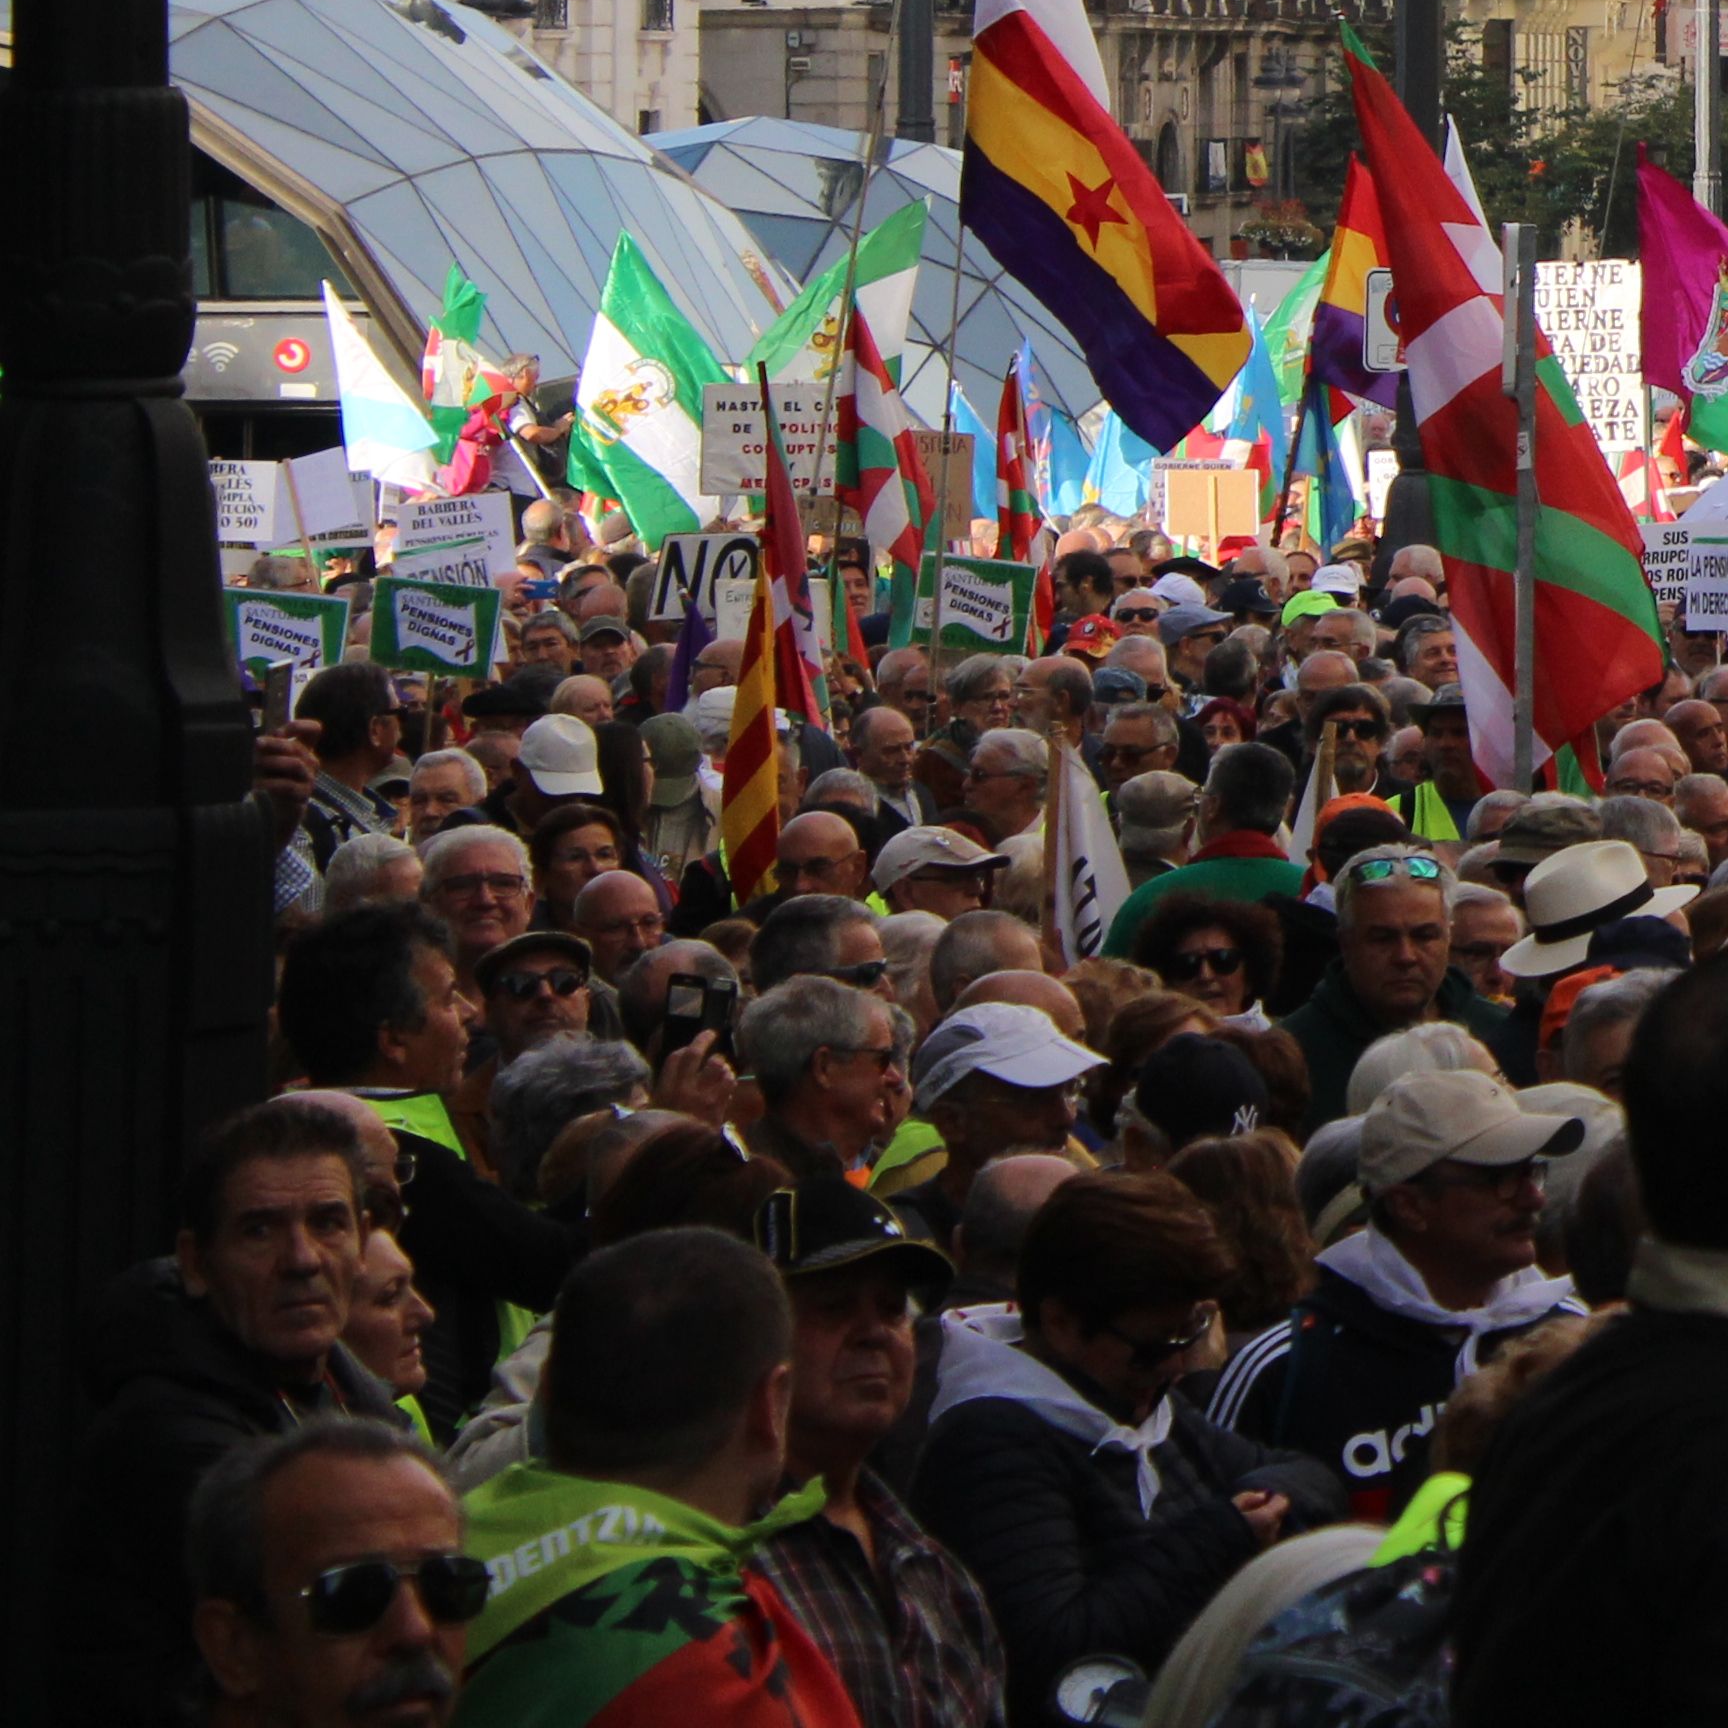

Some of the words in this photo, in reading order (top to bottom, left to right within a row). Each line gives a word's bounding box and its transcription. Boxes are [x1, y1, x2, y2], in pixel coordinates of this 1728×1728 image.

[1590, 332, 1622, 353] DE
[783, 401, 803, 412] EL
[732, 423, 752, 435] DE
[1663, 531, 1689, 545] SUS
[1691, 559, 1702, 578] LA
[943, 581, 1011, 616] PENSIONES
[401, 603, 474, 638] PENSIONES
[948, 598, 994, 624] DIGNAS
[244, 616, 321, 648] PENSIONES
[407, 621, 457, 646] DIGNAS
[250, 633, 301, 657] DIGNAS
